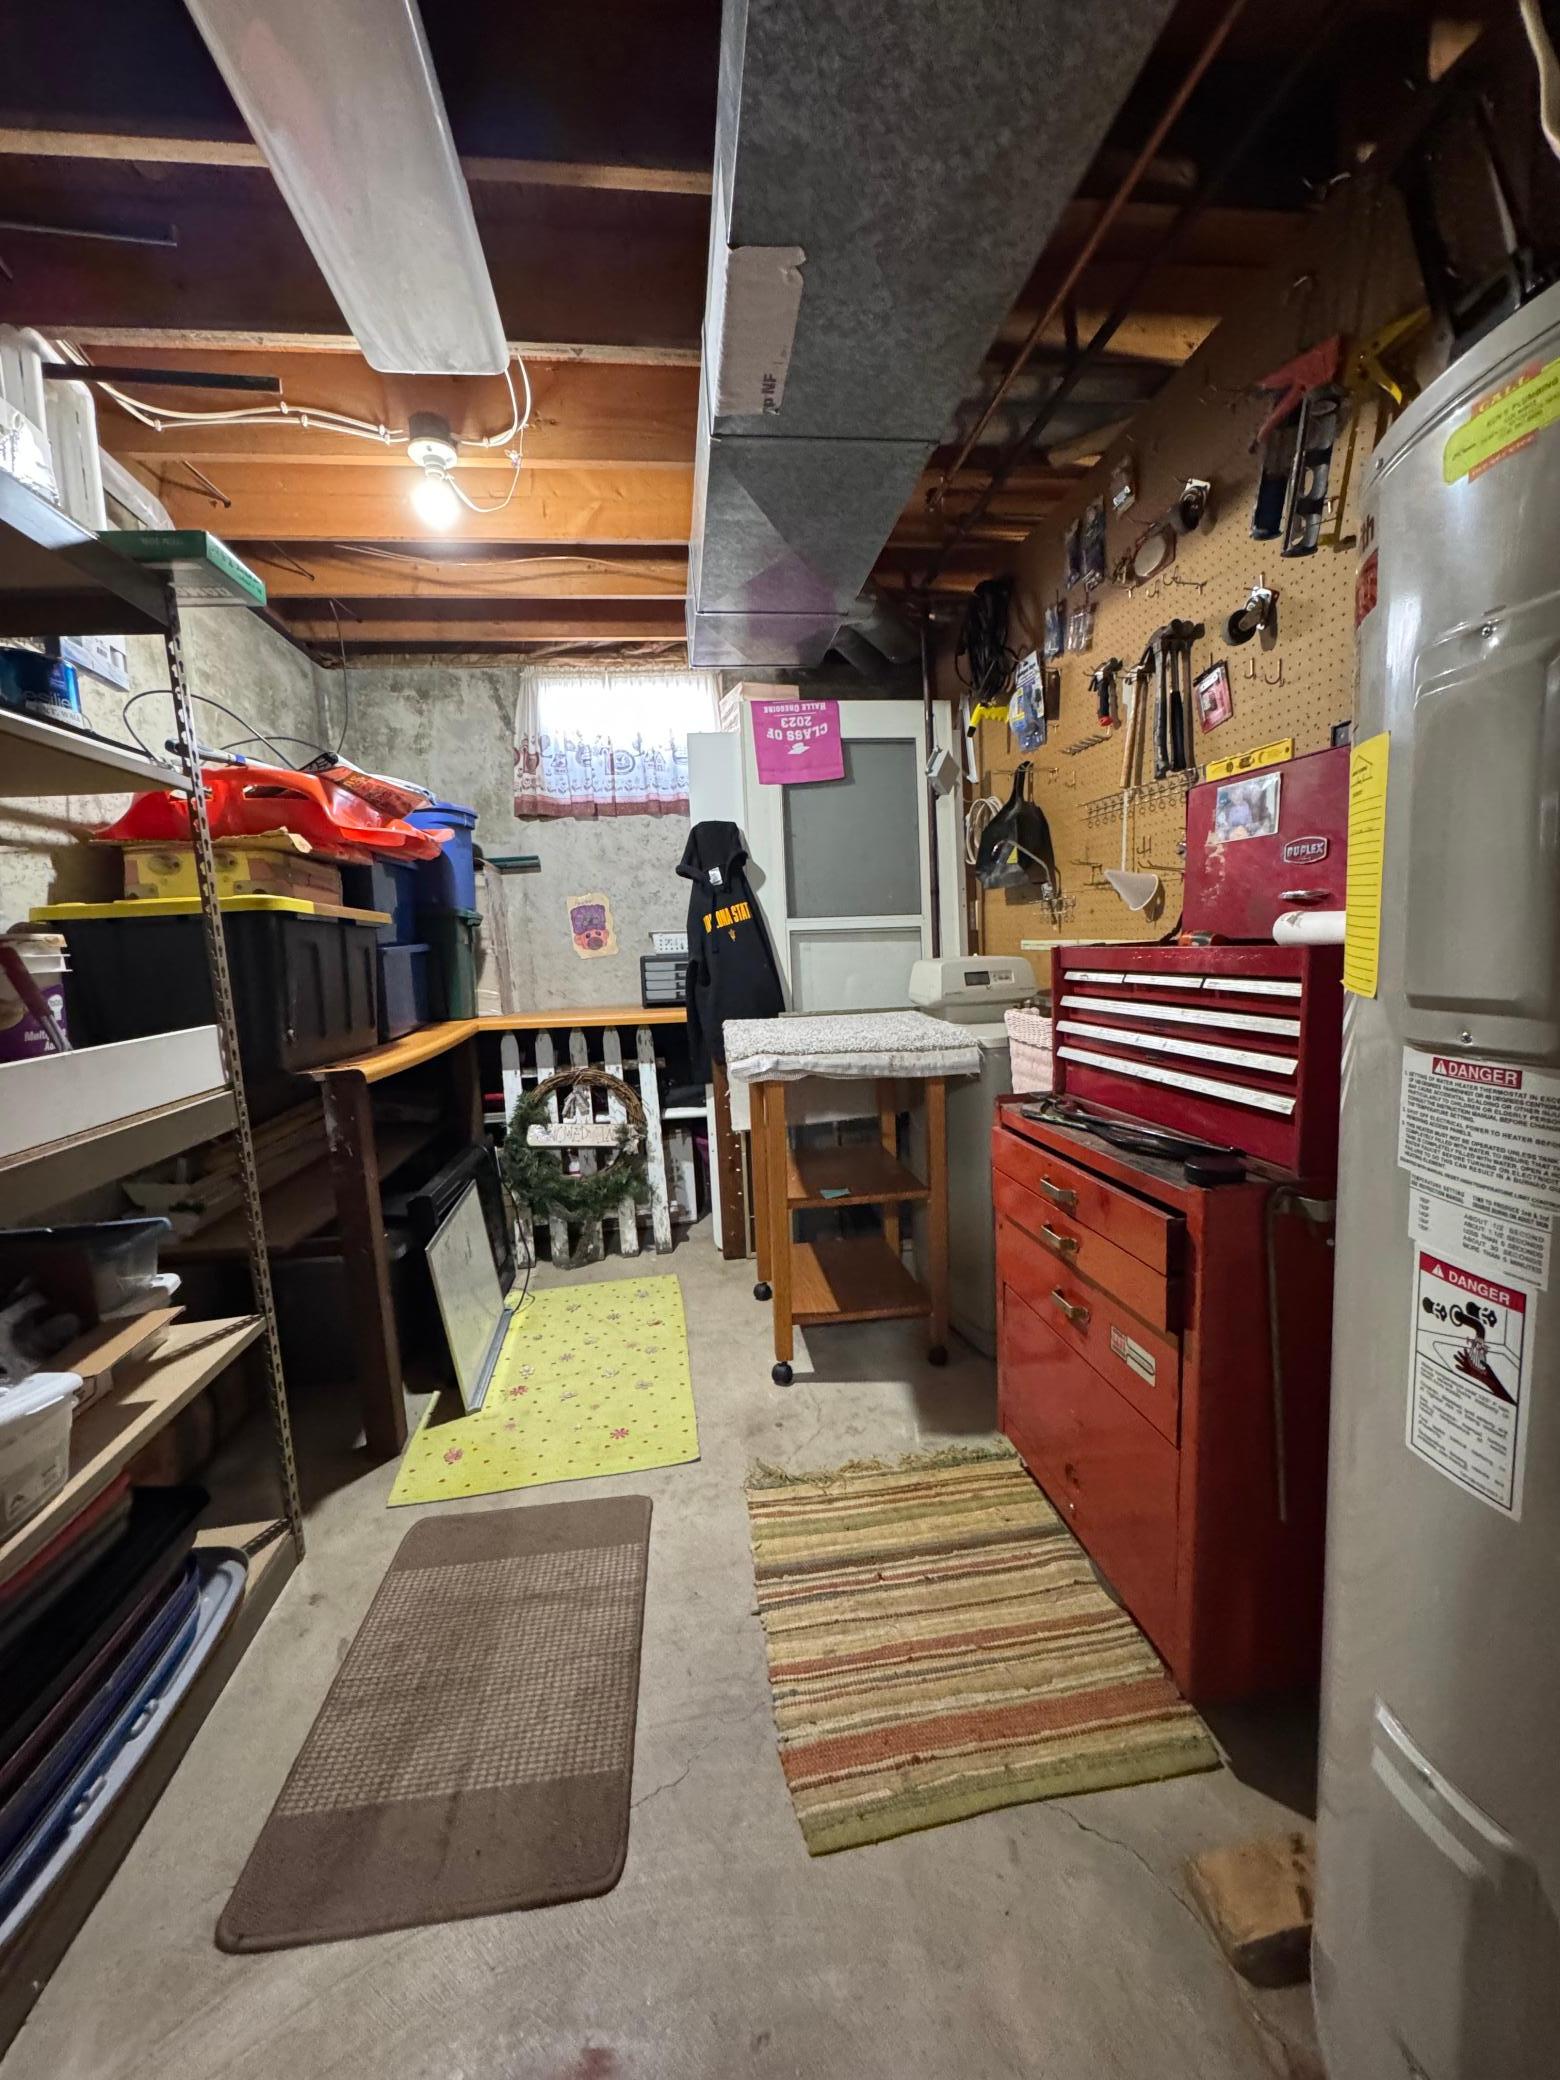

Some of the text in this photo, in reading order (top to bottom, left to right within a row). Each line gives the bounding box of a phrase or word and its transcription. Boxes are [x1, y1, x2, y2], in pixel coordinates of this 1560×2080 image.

[800, 702, 827, 711] HALLE
[766, 723, 829, 741] CLASS OF
[780, 716, 813, 728] 2023
[1286, 842, 1325, 857] DUPLEX
[1448, 1062, 1518, 1085] DANGER
[1436, 1077, 1453, 1086] WATER
[1454, 1082, 1478, 1091] HEATER
[1480, 1087, 1527, 1099] THERMOSTAT
[1450, 1100, 1481, 1111] CHILDREN
[1494, 1109, 1527, 1119] ELDERLY
[1467, 1097, 1500, 1108] SCALDING
[1513, 1106, 1540, 1115] OTHER
[1429, 1115, 1463, 1128] ELECTRICAL
[1465, 1124, 1489, 1134] POWER
[1490, 1129, 1500, 1137] TO
[1502, 1133, 1533, 1143] HEATER
[1499, 1116, 1529, 1127] BEFORE
[1421, 1138, 1454, 1152] COMPLETELY
[1455, 1149, 1476, 1159] FILLED
[1476, 1155, 1492, 1163] WITH
[1520, 1165, 1542, 1175] OPEN
[1442, 1151, 1466, 1162] BEFORE
[1467, 1159, 1497, 1171] TURNING
[1498, 1166, 1510, 1174] ON
[1471, 1140, 1506, 1153] OPERATED
[1507, 1149, 1537, 1160] UNLESS
[1538, 1155, 1559, 1164] TANK
[1503, 1155, 1530, 1165] INSURE
[1531, 1161, 1551, 1170] THAT
[1440, 1157, 1453, 1165] THIS
[1454, 1161, 1468, 1169] CAN
[1468, 1165, 1495, 1177] RESULT
[1493, 1201, 1520, 1214] PRODUCE
[1464, 1214, 1488, 1226] ABOUT
[1508, 1227, 1545, 1243] SECOND
[1464, 1221, 1485, 1232] ABOUT
[1506, 1234, 1544, 1251] SECONDS
[1463, 1228, 1479, 1238] LESS
[1481, 1233, 1498, 1244] THAN
[1507, 1243, 1544, 1259] SECONDS
[1463, 1235, 1543, 1267] ABOUT 30 SECONDS
[1462, 1242, 1480, 1253] MORE
[1483, 1249, 1501, 1260] THAN
[1509, 1258, 1543, 1275] MINUTES
[1448, 1269, 1511, 1306] DANGER
